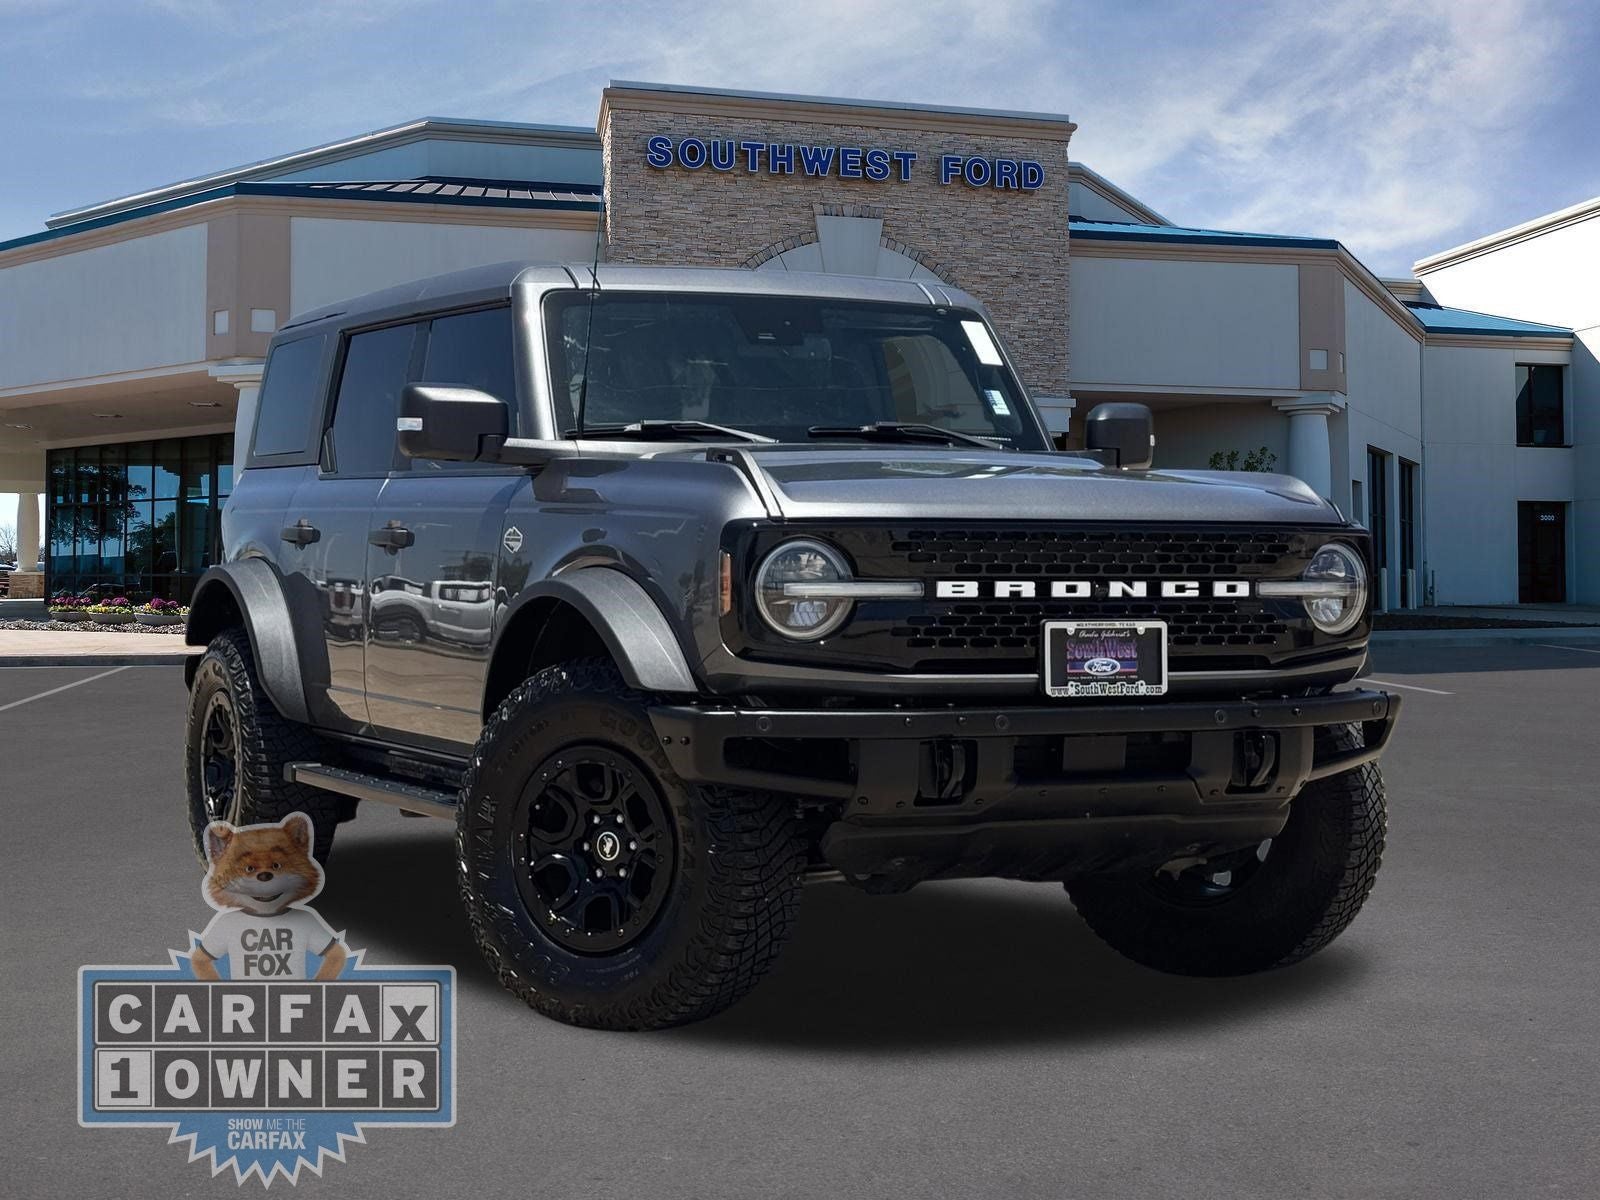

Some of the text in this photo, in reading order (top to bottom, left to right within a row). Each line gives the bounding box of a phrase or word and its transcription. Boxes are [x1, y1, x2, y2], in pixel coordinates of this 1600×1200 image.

[646, 135, 1045, 191] SOUTHWEST FORD
[936, 580, 1250, 598] BRONCO
[1092, 661, 1113, 672] Ford
